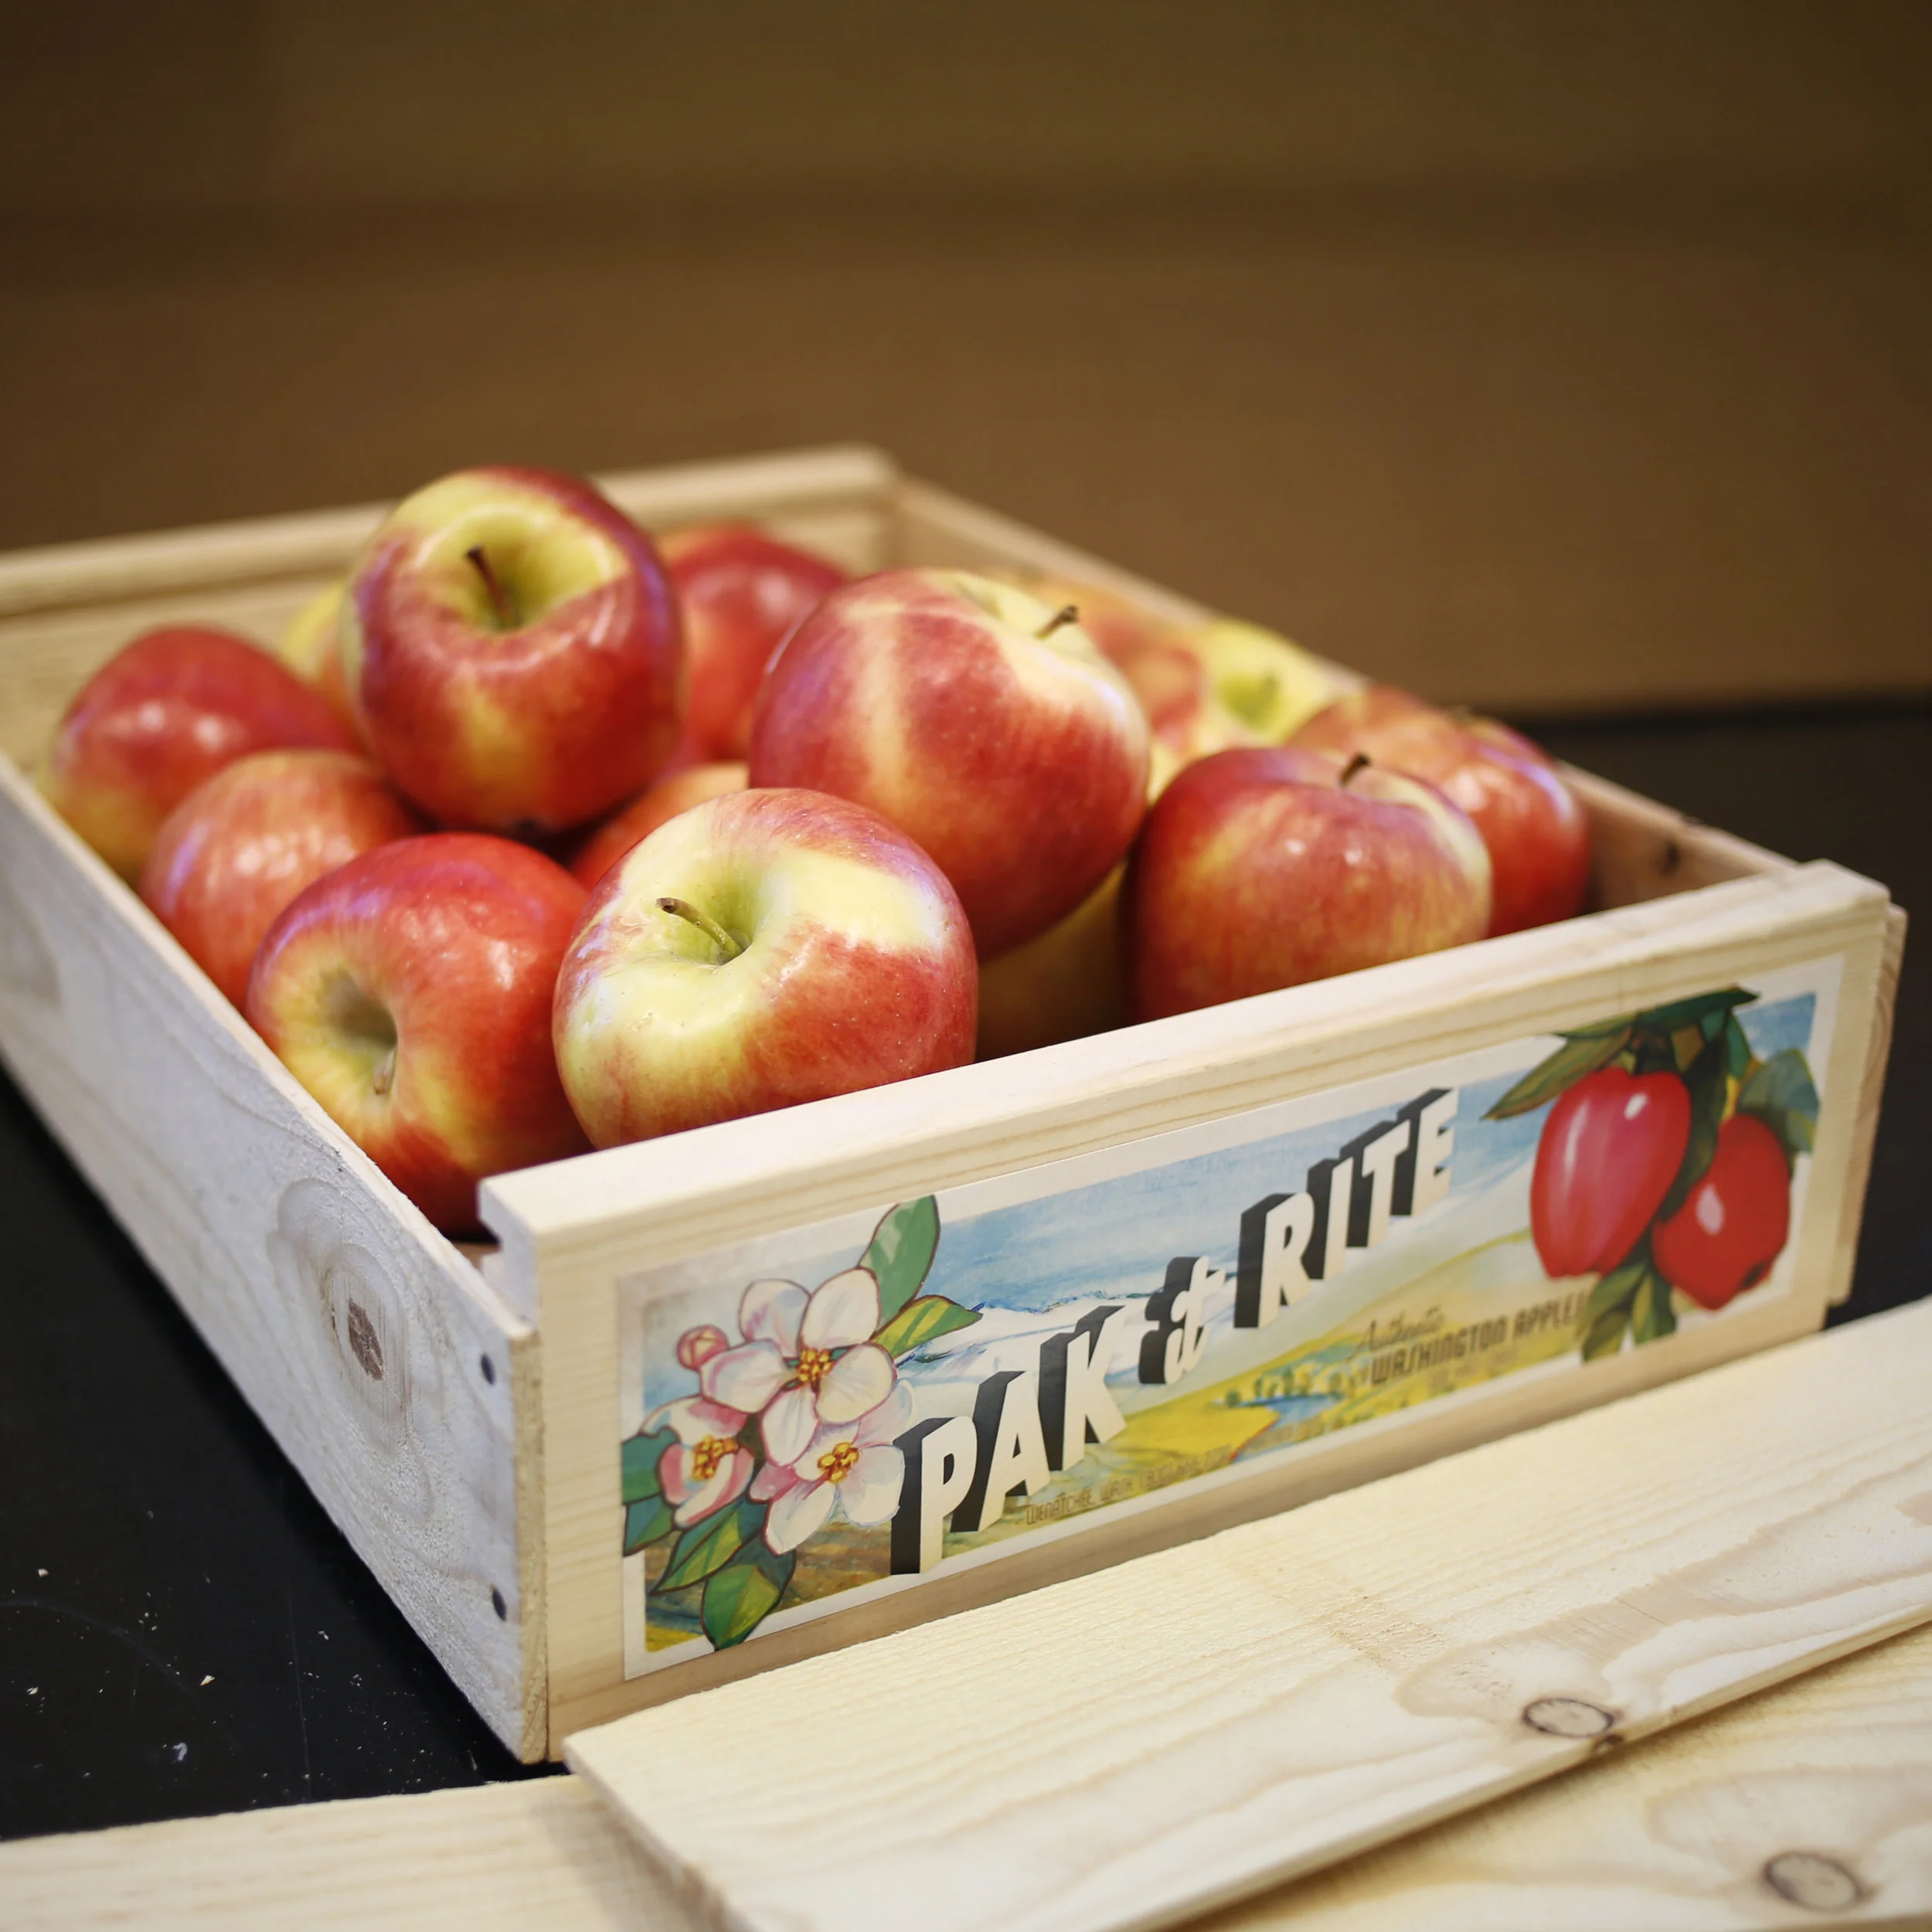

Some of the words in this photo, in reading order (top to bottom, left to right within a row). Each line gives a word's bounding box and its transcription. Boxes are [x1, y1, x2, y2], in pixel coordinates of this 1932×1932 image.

[890, 1304, 1127, 1575] PAK
[1234, 1087, 1460, 1329] RITE
[1369, 1313, 1507, 1386] WASHINGTON
